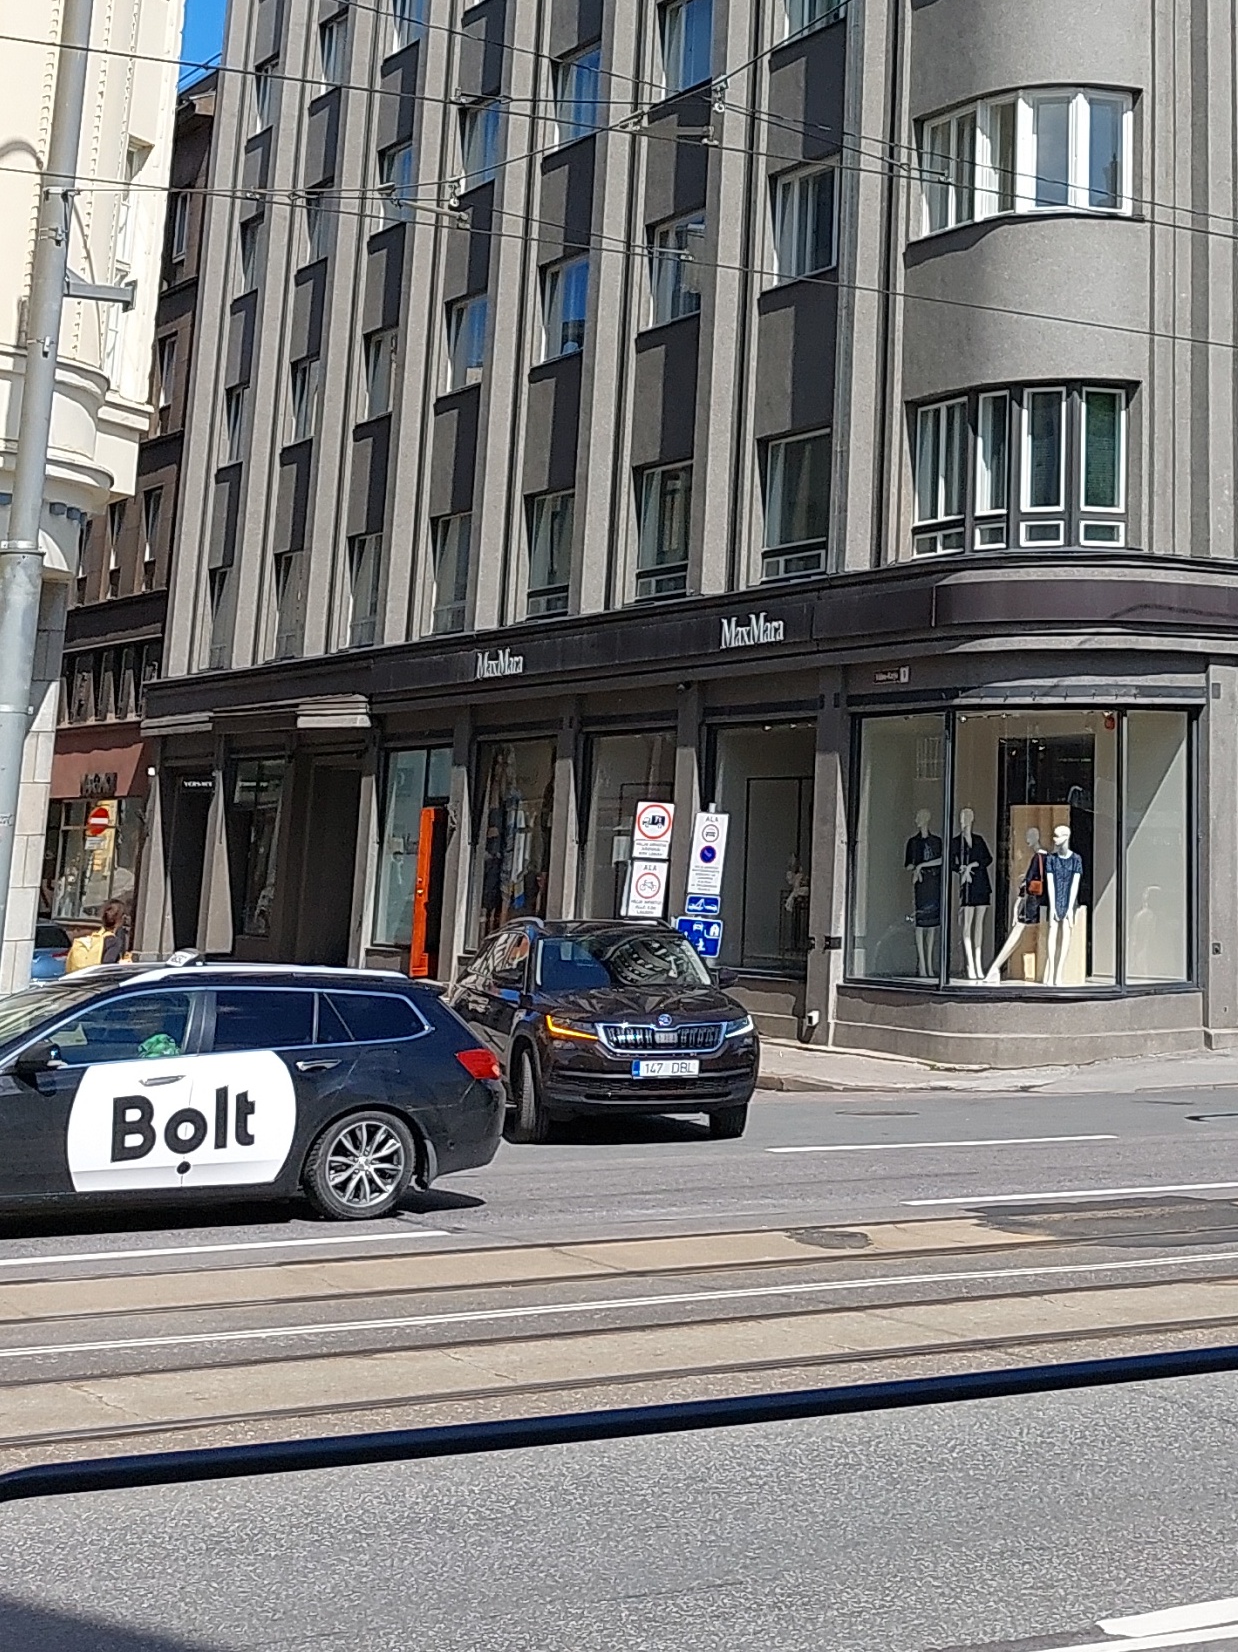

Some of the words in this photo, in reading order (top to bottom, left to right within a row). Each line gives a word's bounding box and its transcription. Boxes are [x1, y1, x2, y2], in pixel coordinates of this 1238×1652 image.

[721, 612, 784, 650] MaxMara
[477, 648, 523, 679] MaxMara
[645, 1062, 664, 1074] 147
[671, 1062, 695, 1074] DBL
[111, 1085, 256, 1164] Bolt
